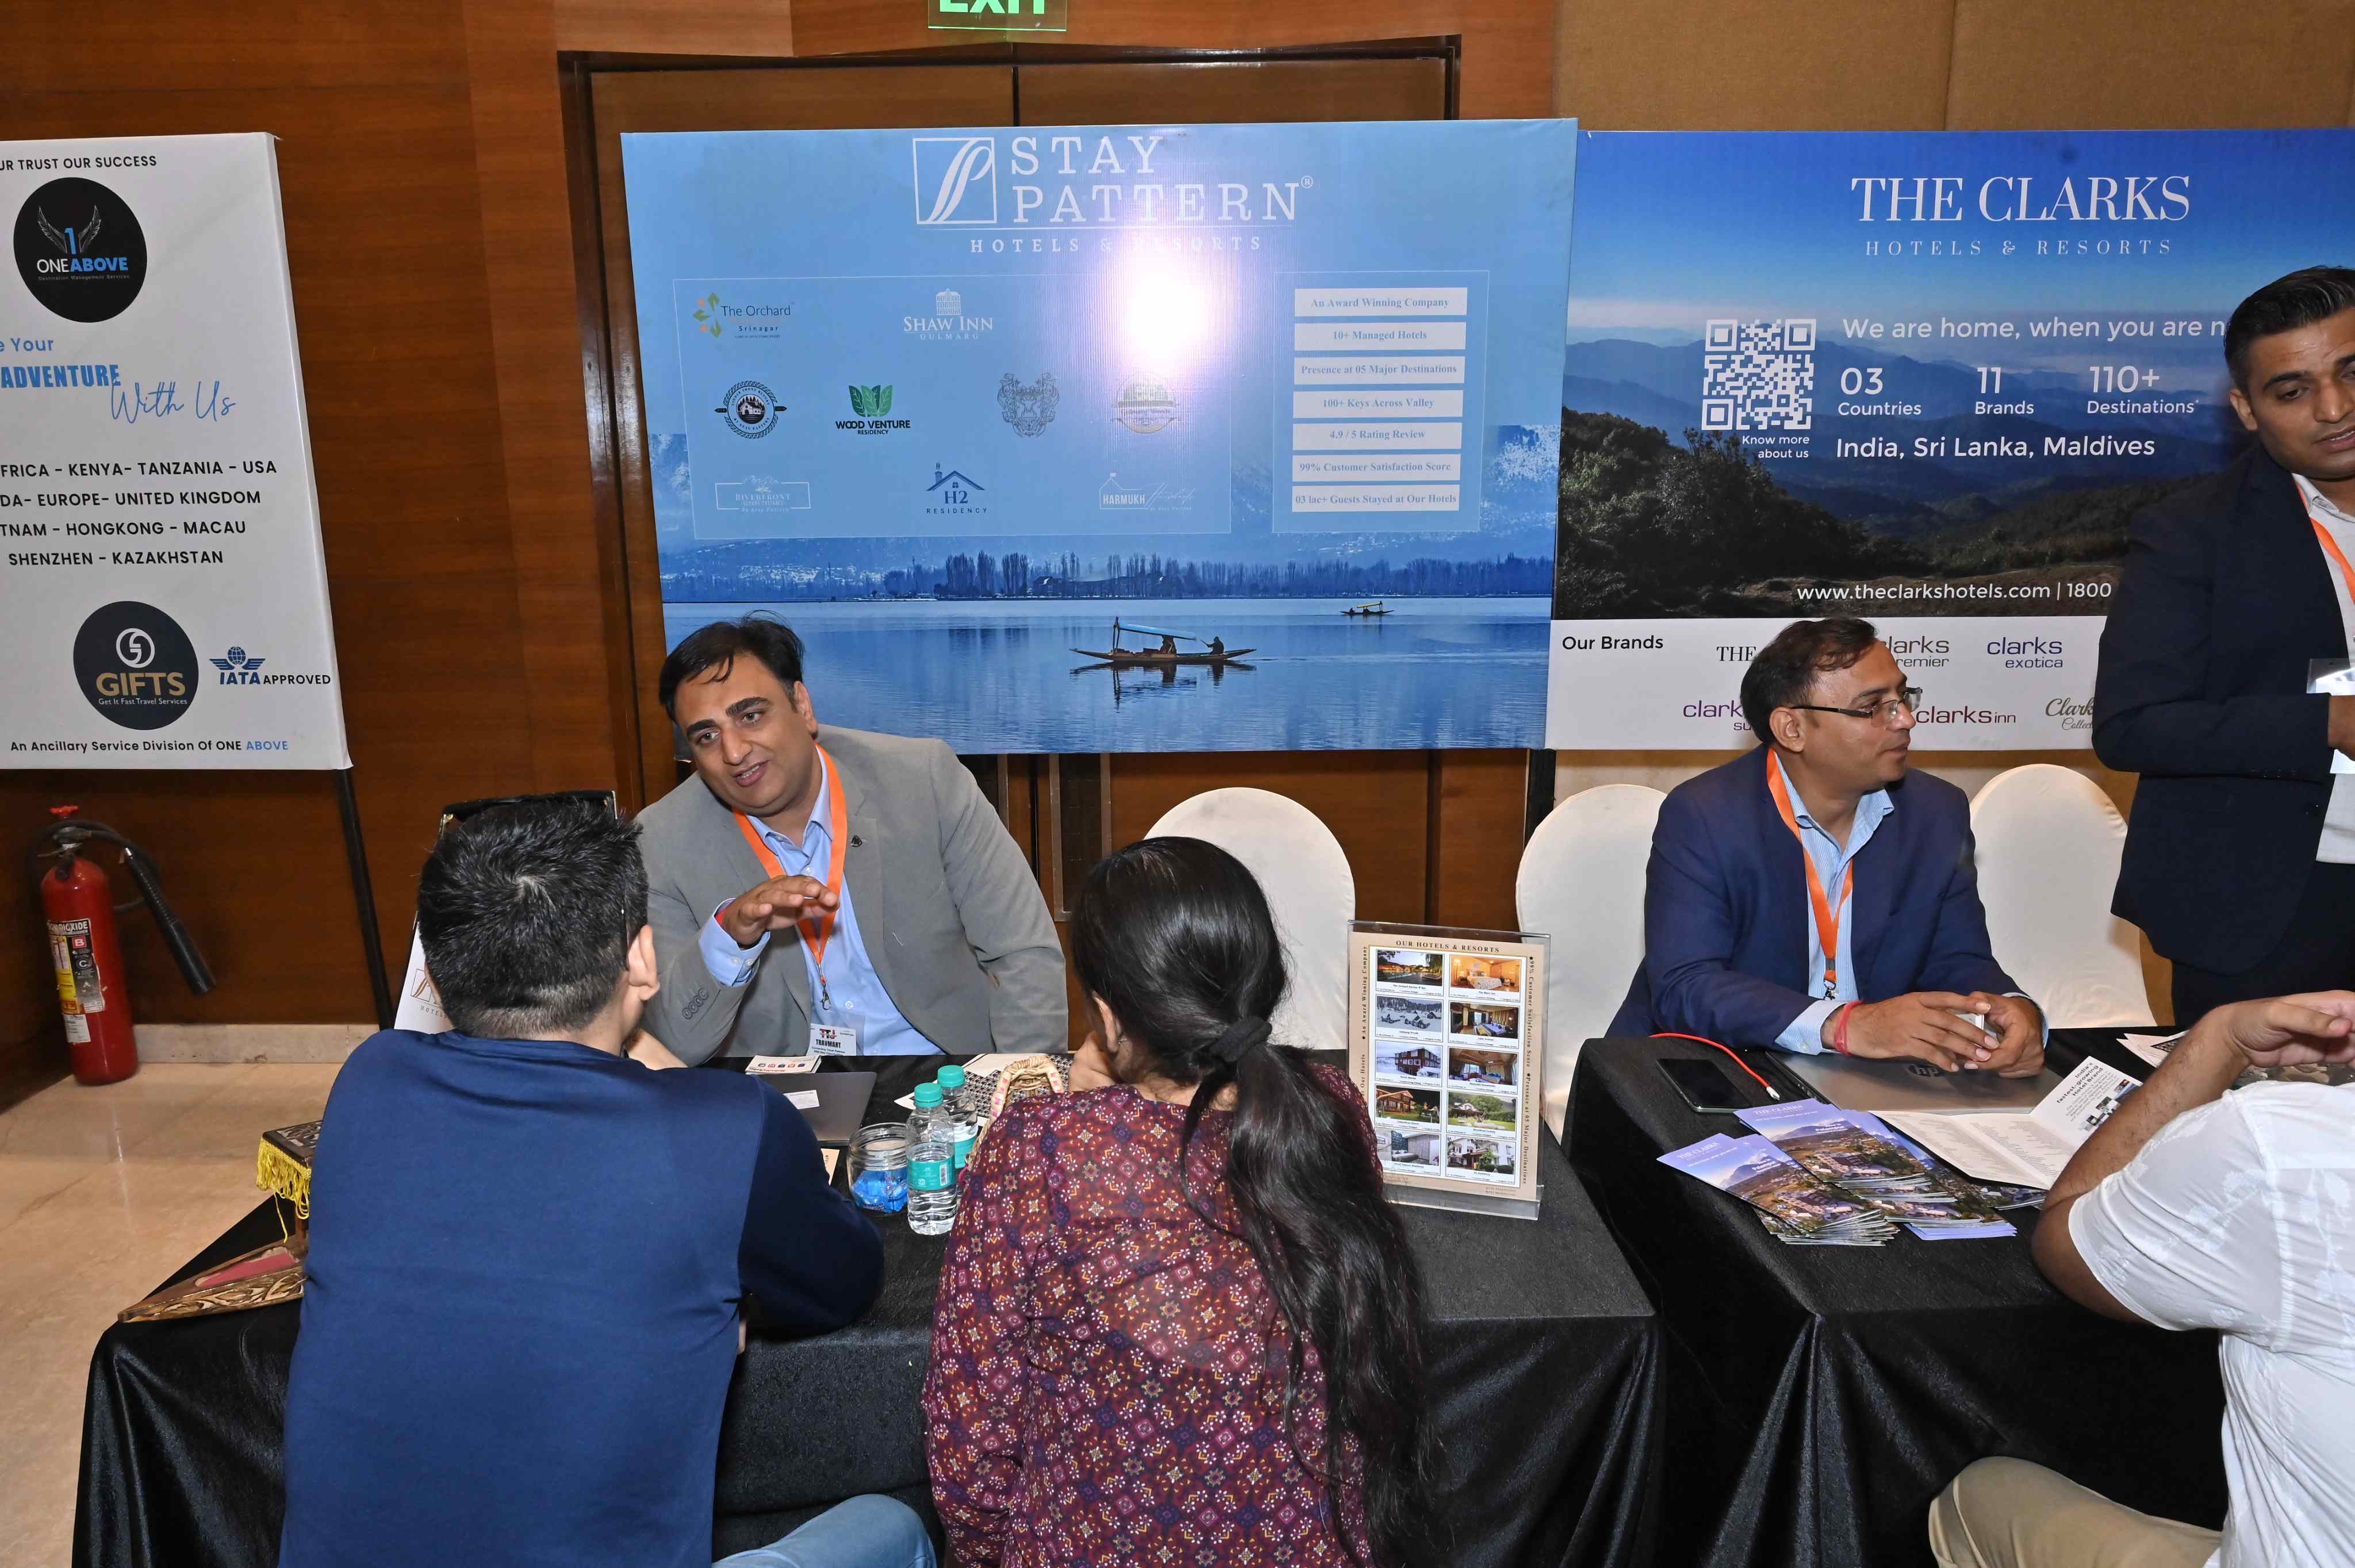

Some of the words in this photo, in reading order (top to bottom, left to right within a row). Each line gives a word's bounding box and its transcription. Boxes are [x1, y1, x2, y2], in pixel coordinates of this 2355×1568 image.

[18, 159, 58, 170] TRUST
[63, 157, 91, 169] OUR
[95, 155, 157, 168] SUCCESS
[1011, 136, 1163, 175] STAY
[1851, 177, 1963, 222] THE
[1980, 175, 2189, 222] CLARKS
[971, 239, 1079, 253] HOTELS
[1866, 240, 1982, 256] HOTELS
[2003, 240, 2016, 255] &
[2037, 239, 2172, 255] RESORTS
[721, 306, 742, 316] The
[746, 305, 791, 316] Orchard
[1311, 299, 1324, 307] An
[1328, 298, 1359, 307] Award
[1362, 298, 1402, 309] Winning
[1405, 298, 1449, 309] Company
[960, 316, 994, 331] INN
[1843, 318, 1884, 338] We
[1892, 323, 1932, 338] are
[1940, 317, 2020, 340] home,
[2030, 317, 2099, 337] when
[2107, 321, 2154, 342] you
[2162, 320, 2203, 336] are
[1333, 331, 1349, 340] 10+
[1352, 332, 1394, 341] Managed
[1398, 331, 1426, 340] Hotels
[10, 338, 53, 352] Your
[1, 364, 121, 389] ADVENTURE
[1302, 366, 1342, 374] Presence
[1355, 366, 1366, 374] 05
[1370, 366, 1397, 375] Major
[1401, 365, 1456, 374] Destinations
[1840, 367, 1884, 395] 03
[1977, 367, 2001, 394] 11
[2089, 366, 2160, 393] 110+
[111, 380, 184, 424] With
[196, 380, 236, 421] Us
[1323, 399, 1344, 408] 100+
[1348, 399, 1369, 409] Keys
[1372, 399, 1402, 408] Across
[1405, 398, 1435, 409] Valley
[1838, 401, 1921, 416] Countries
[1975, 400, 2034, 415] Brands
[835, 420, 865, 430] WOOD
[868, 420, 911, 429] VENTURE
[1330, 431, 1343, 439] 4.9
[1352, 431, 1356, 439] 5
[1360, 431, 1390, 440] Rating
[1393, 430, 1425, 439] Review
[1742, 436, 1774, 445] Know
[1779, 437, 1810, 445] more
[1758, 449, 1792, 458] about
[1836, 437, 1905, 460] India,
[1913, 436, 1945, 458] Sri
[1954, 436, 2034, 459] Lanka,
[2043, 435, 2155, 455] Maldives
[1, 464, 49, 477] FRICA
[138, 462, 223, 475] TANZANIA
[243, 460, 277, 474] USA
[1300, 463, 1320, 471] 99%
[1324, 463, 1368, 471] Customer
[1371, 463, 1423, 471] Satisfaction
[1426, 462, 1450, 471] Score
[116, 492, 175, 505] UNITED
[180, 491, 260, 505] KINGDOM
[944, 490, 968, 505] H2
[1103, 494, 1145, 505] HARMUKH
[1296, 496, 1306, 504] 03
[1308, 495, 1328, 504] lac+
[1330, 495, 1360, 504] Guests
[1363, 495, 1393, 505] Stayed
[1407, 495, 1425, 504] Our
[1429, 495, 1456, 504] Hotels
[0, 524, 47, 536] TNAM
[66, 522, 164, 536] HONGKONG
[183, 521, 246, 535] MACAU
[9, 552, 93, 566] SHENZHEN
[113, 551, 224, 565] KAZAKHSTAN
[1797, 583, 2050, 599] www.theclarkshotels.com
[2068, 582, 2112, 598] 1800
[1563, 636, 1595, 650] Our
[1602, 635, 1663, 650] Brands
[1716, 646, 1756, 662] THE
[1886, 636, 1950, 654] larks
[1986, 637, 2062, 655] clarks
[1896, 656, 1950, 667] remier
[2005, 658, 2063, 668] exotica
[96, 672, 185, 697] GIFTS
[219, 671, 261, 685] IATA
[263, 674, 331, 685] APPROVED
[1683, 700, 1744, 717] clark
[2045, 697, 2094, 717] Clark
[10, 741, 27, 751] An
[31, 741, 87, 754] Ancillary
[92, 741, 139, 751] Service
[143, 741, 194, 751] Division
[198, 741, 213, 751] Of
[216, 741, 241, 751] ONE
[246, 740, 288, 750] ABOVE
[75, 939, 84, 947] B
[1417, 941, 1449, 950] HOTELS
[1462, 944, 1499, 953] RESORTS
[79, 960, 87, 968] C
[1362, 1025, 1367, 1034] An
[816, 1039, 841, 1048] TRAVMART
[1913, 1064, 1939, 1077] hp
[2074, 1062, 2093, 1078] India's
[2056, 1065, 2099, 1104] fastest-growing
[2072, 1082, 2088, 1096] Hotel
[2088, 1067, 2104, 1082] Brand
